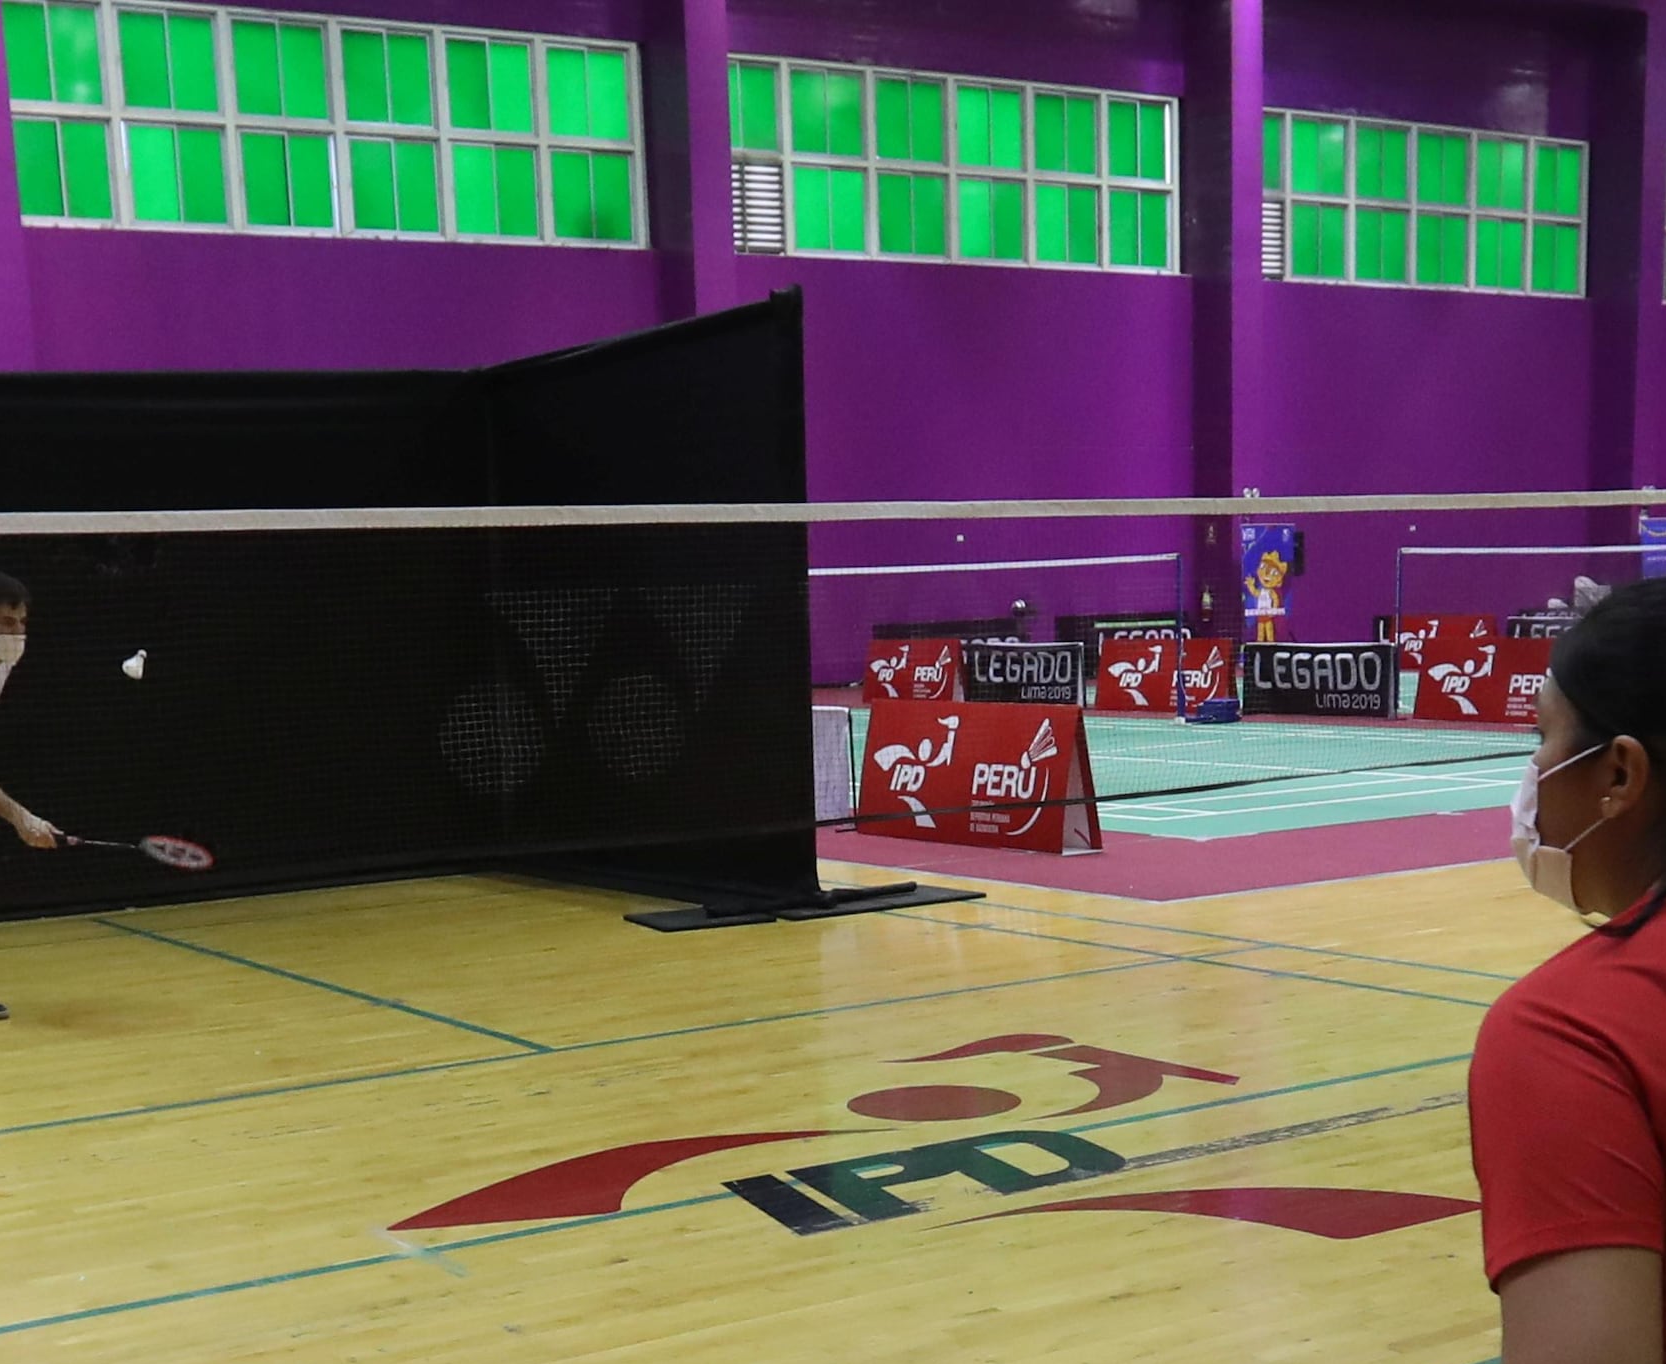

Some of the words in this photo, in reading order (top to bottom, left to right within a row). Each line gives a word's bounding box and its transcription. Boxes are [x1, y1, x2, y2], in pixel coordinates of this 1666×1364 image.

[975, 651, 1071, 683] LEGADO
[1254, 651, 1381, 690] LEGADO
[1048, 686, 1071, 699] 2019
[1441, 676, 1471, 693] IPD
[1509, 674, 1545, 695] PER
[1351, 693, 1381, 710] 2019
[889, 764, 925, 792] IPD
[720, 1129, 1130, 1236] IPD
